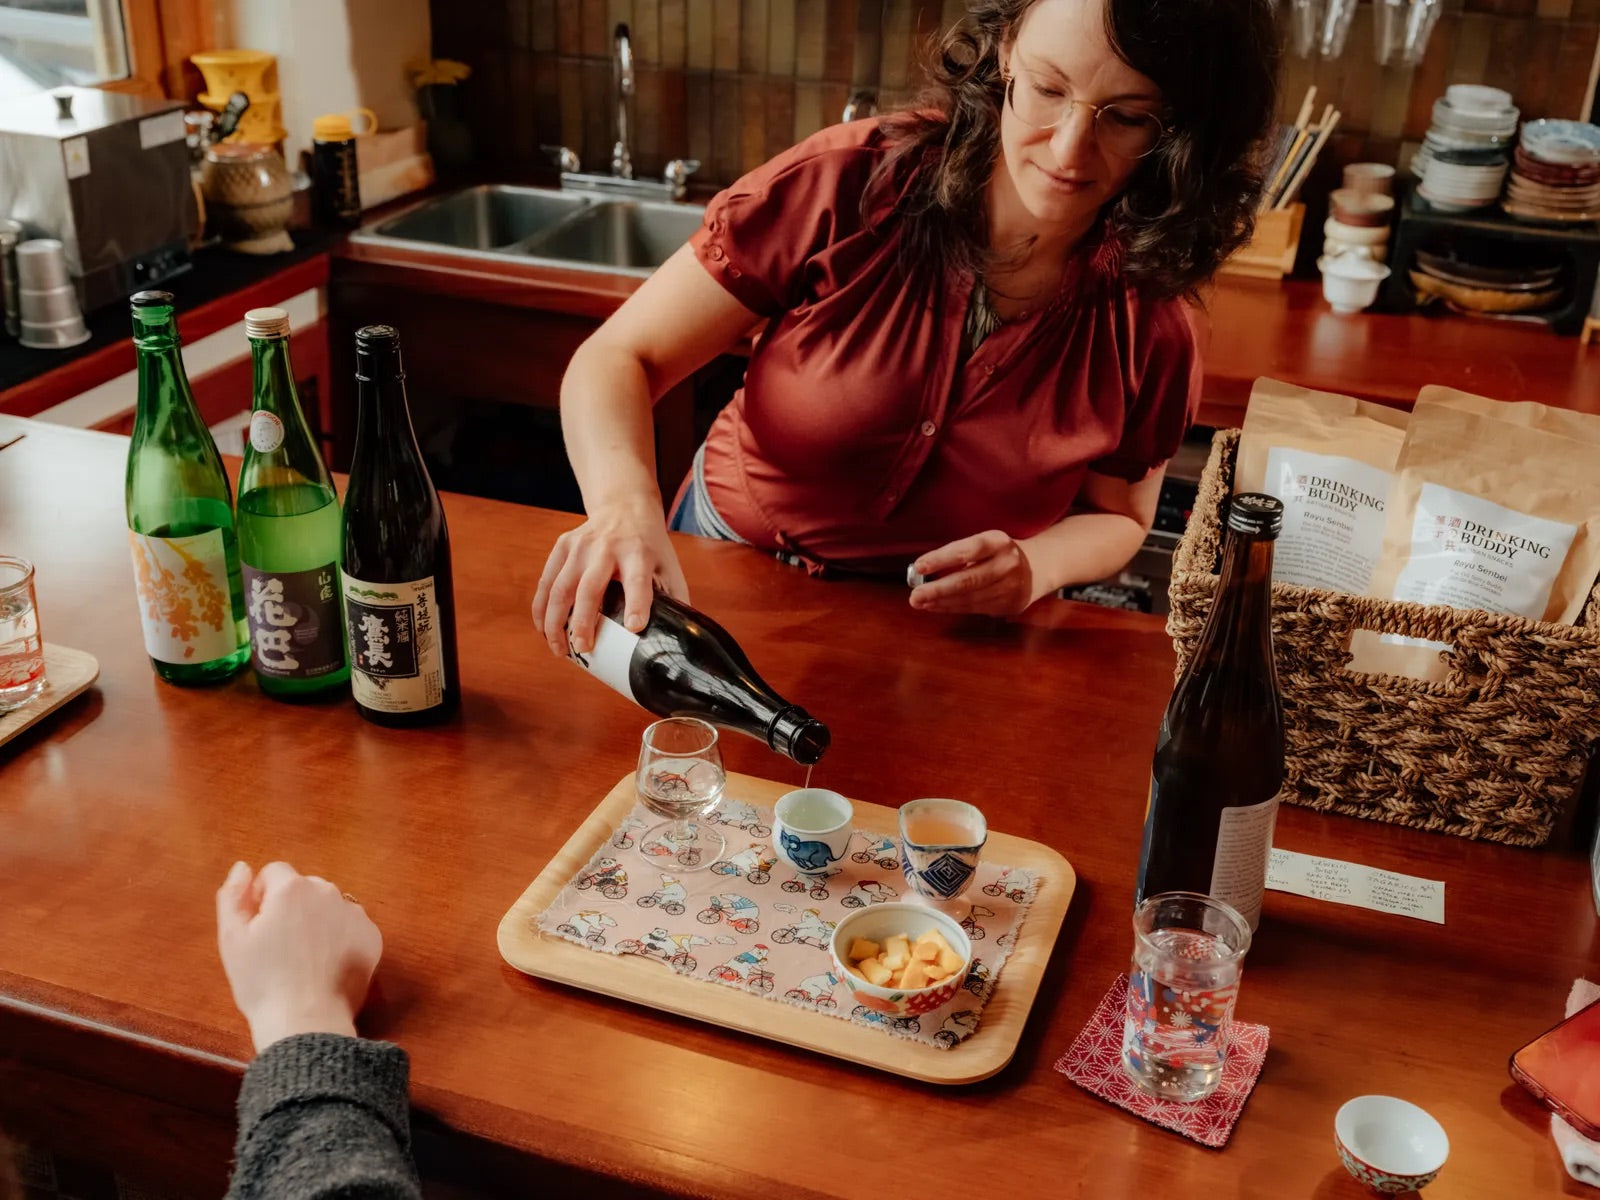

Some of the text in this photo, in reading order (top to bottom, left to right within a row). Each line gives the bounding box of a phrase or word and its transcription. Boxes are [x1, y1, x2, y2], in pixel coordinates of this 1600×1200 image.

[1308, 487, 1358, 512] BUDDY
[1311, 476, 1385, 512] DRINKING
[1303, 511, 1325, 522] Rayu
[1461, 532, 1518, 559] BUDDY
[1465, 520, 1551, 560] DRINKING
[1453, 559, 1476, 570] Rayu
[1477, 564, 1508, 583] Senbei
